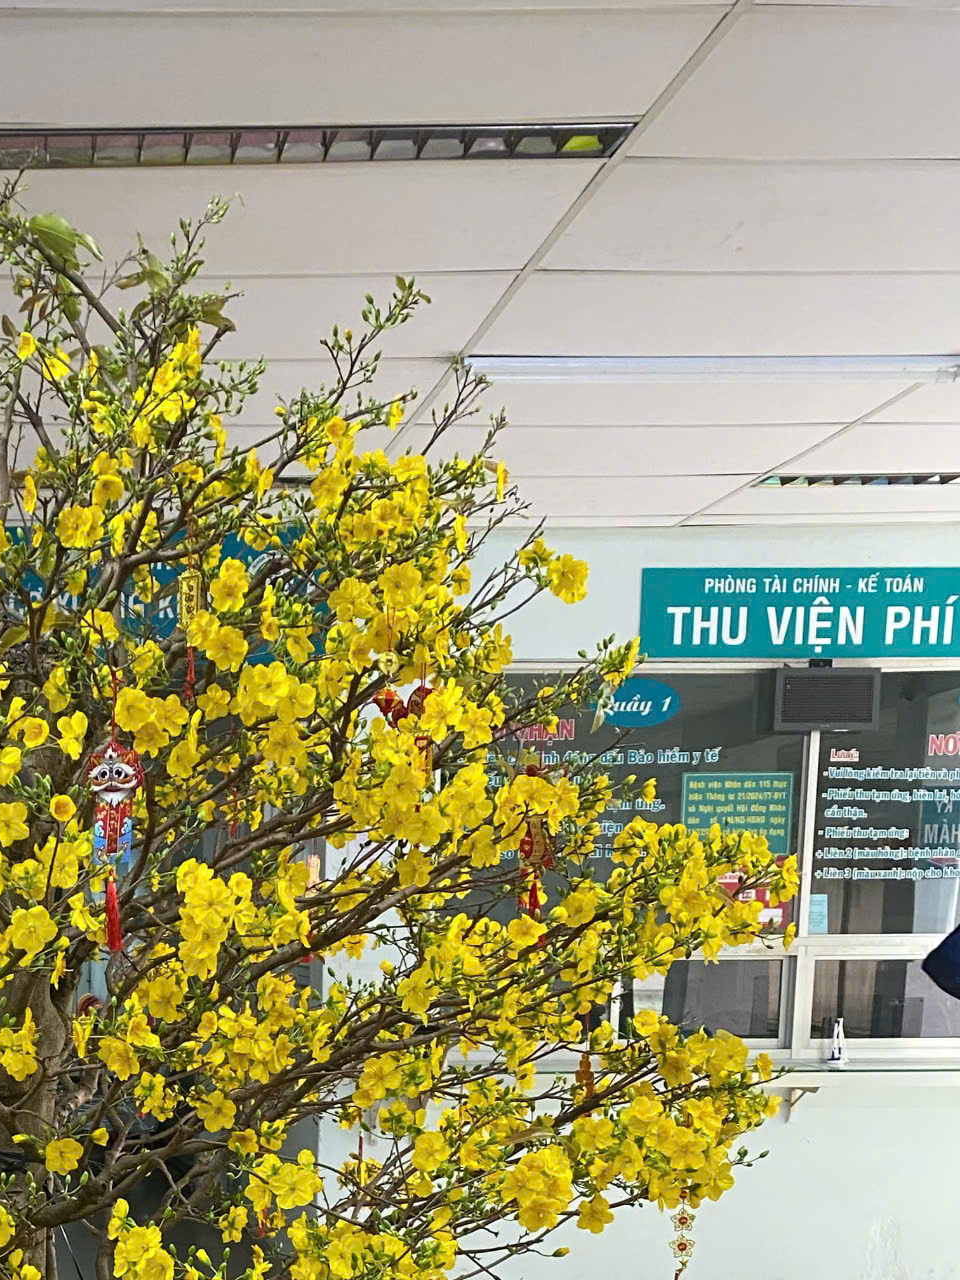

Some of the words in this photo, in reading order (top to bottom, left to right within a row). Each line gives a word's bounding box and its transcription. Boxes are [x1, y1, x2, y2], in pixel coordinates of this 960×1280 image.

[704, 575, 757, 593] PHÒNG
[763, 576, 787, 593] TÀI
[793, 575, 840, 593] CHÍNH
[858, 572, 881, 593] KẾ
[885, 574, 925, 593] TOÁN
[667, 605, 748, 646] THU
[767, 596, 865, 654] VIỆN
[884, 595, 960, 646] PHÍ
[661, 696, 672, 713] 1
[628, 748, 654, 765] Bảo
[657, 747, 691, 764] hiểm
[692, 752, 702, 766] y
[704, 745, 723, 762] tế
[937, 768, 948, 779] và
[827, 787, 854, 800] Phiếu
[855, 788, 871, 800] thu
[871, 789, 890, 802] tạm
[825, 826, 852, 838] Phiếu
[852, 827, 869, 838] thu
[869, 827, 888, 840] tạm
[824, 847, 844, 859] Liên
[845, 847, 852, 859] 2
[908, 847, 931, 860] bệnh
[932, 847, 955, 858] nhân
[823, 867, 844, 879] Liên
[844, 867, 852, 878] 3
[906, 867, 924, 881] nộp
[925, 867, 942, 878] cho
